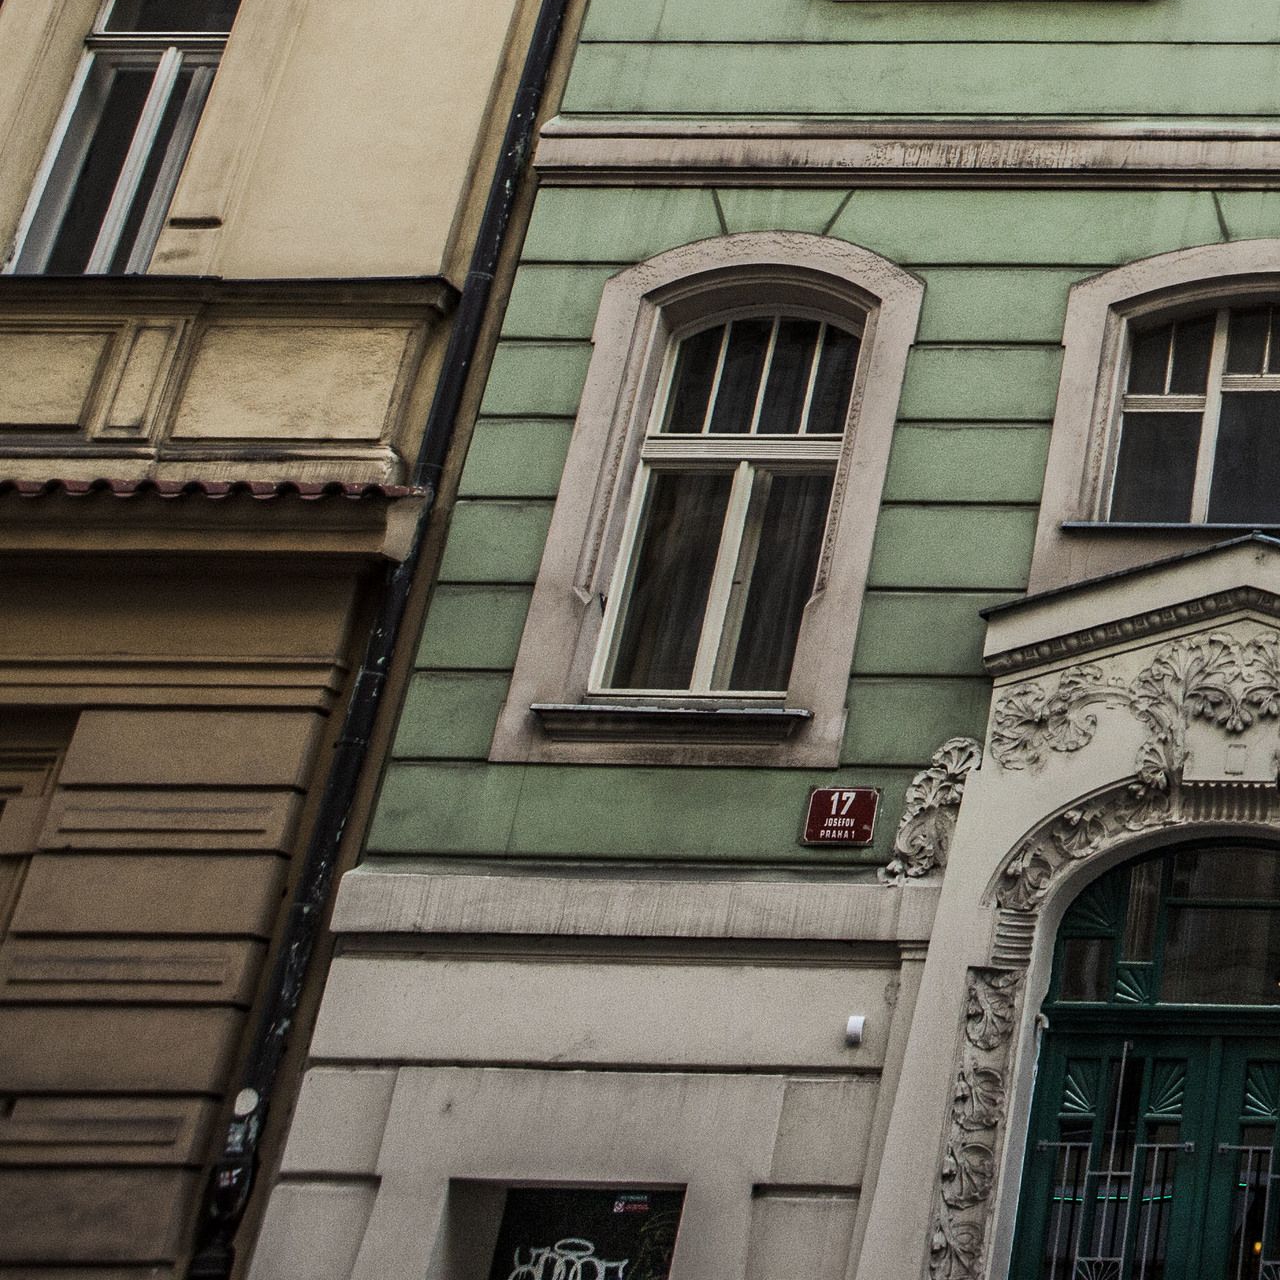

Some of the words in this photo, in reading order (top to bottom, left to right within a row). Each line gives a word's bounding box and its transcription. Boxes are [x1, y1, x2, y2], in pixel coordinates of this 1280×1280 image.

[830, 791, 857, 815] 17
[824, 817, 856, 827] JOSEFOV
[820, 829, 849, 839] PRAHA
[850, 829, 856, 839] 1
